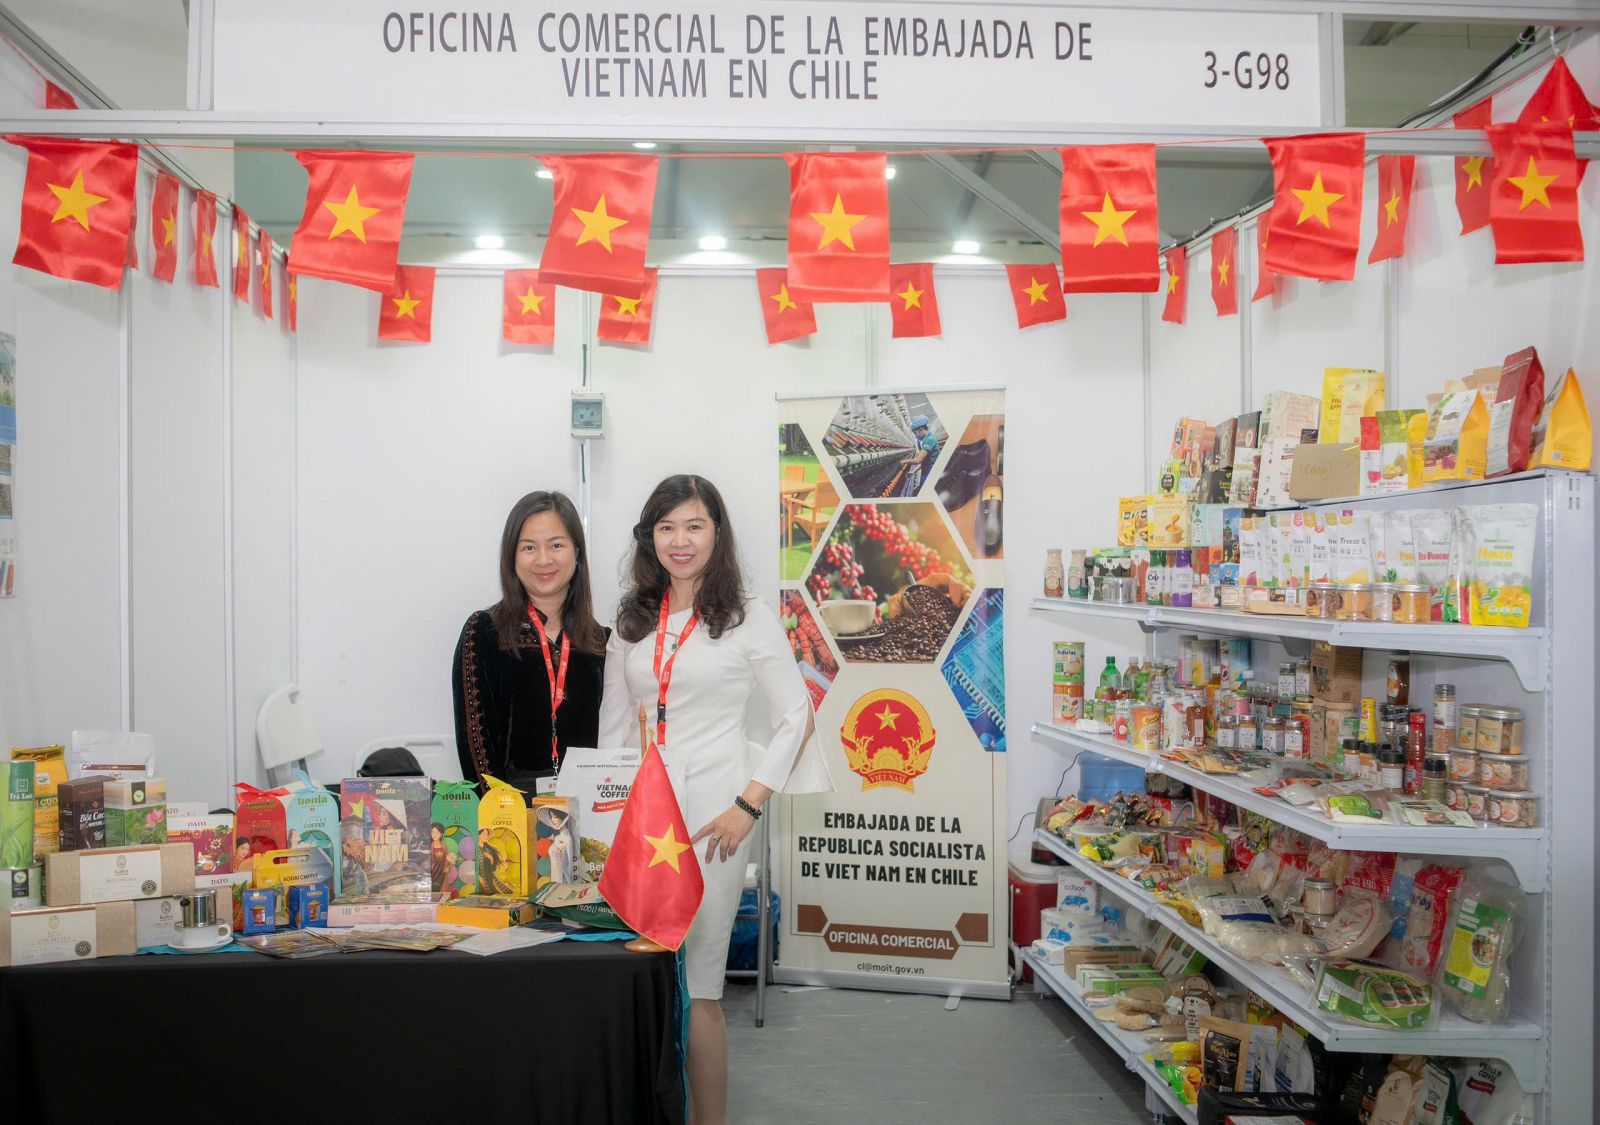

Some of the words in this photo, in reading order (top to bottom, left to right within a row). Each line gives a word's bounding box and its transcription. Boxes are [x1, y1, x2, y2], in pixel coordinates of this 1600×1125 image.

[383, 12, 518, 53] OFICINA
[538, 12, 725, 54] COMERCIAL
[746, 15, 786, 54] DE
[806, 16, 845, 56] LA
[865, 17, 1034, 60] EMBAJADA
[1055, 22, 1094, 61] DE
[561, 58, 708, 98] VIETNAM
[729, 59, 768, 98] EN
[788, 60, 879, 100] CHILE
[1204, 51, 1291, 91] 3-G98
[824, 812, 911, 832] EMBAJADA
[915, 816, 936, 832] DE
[940, 817, 962, 834] LA
[798, 836, 884, 856] REPUBLICA
[889, 840, 986, 861] SOCIALISTA
[801, 861, 820, 878] DE
[825, 863, 861, 880] VIET
[866, 865, 900, 882] NAM
[905, 867, 926, 884] EN
[931, 868, 978, 886] CHILE
[829, 931, 879, 946] OFICINA
[881, 934, 954, 950] COMERCIAL
